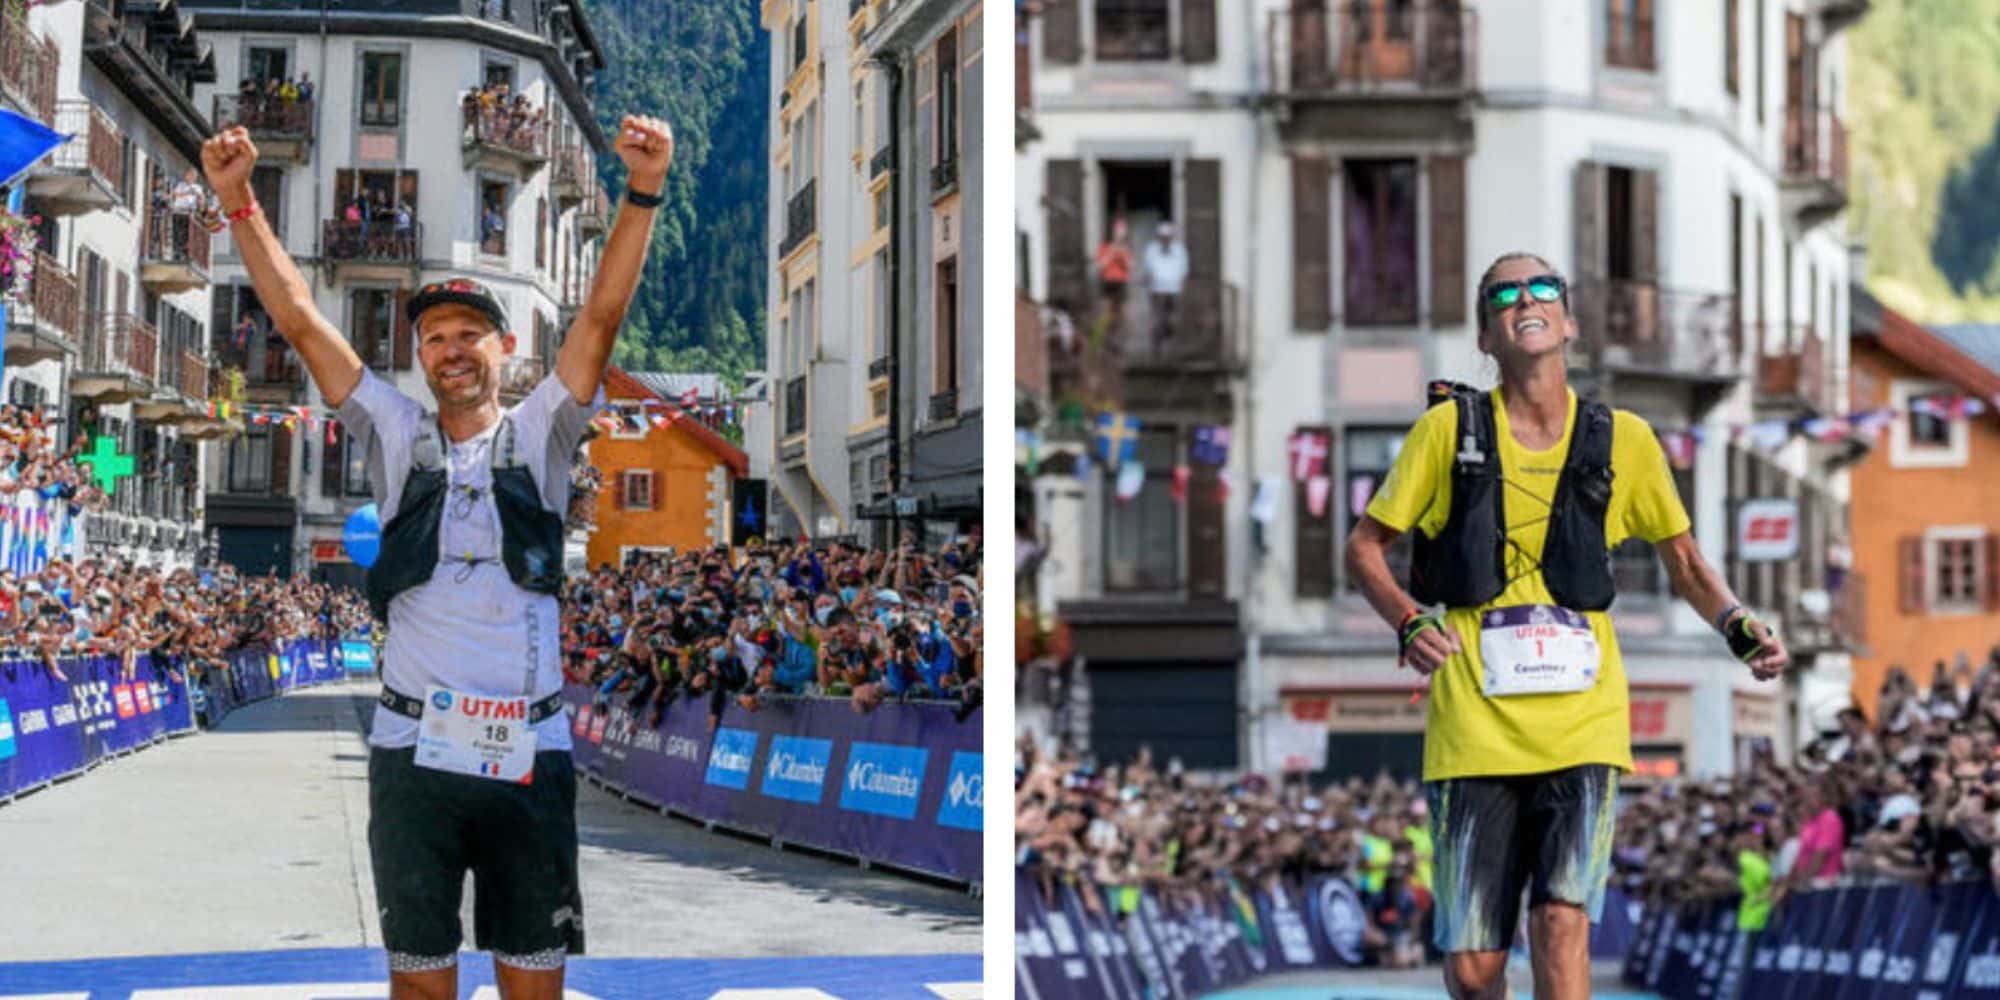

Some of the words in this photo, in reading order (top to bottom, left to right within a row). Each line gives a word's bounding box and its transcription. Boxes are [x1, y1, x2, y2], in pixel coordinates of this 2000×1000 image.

[1514, 625, 1558, 640] UTMB
[1536, 639, 1544, 657] 1
[486, 725, 508, 742] 18
[858, 762, 919, 798] Columbia
